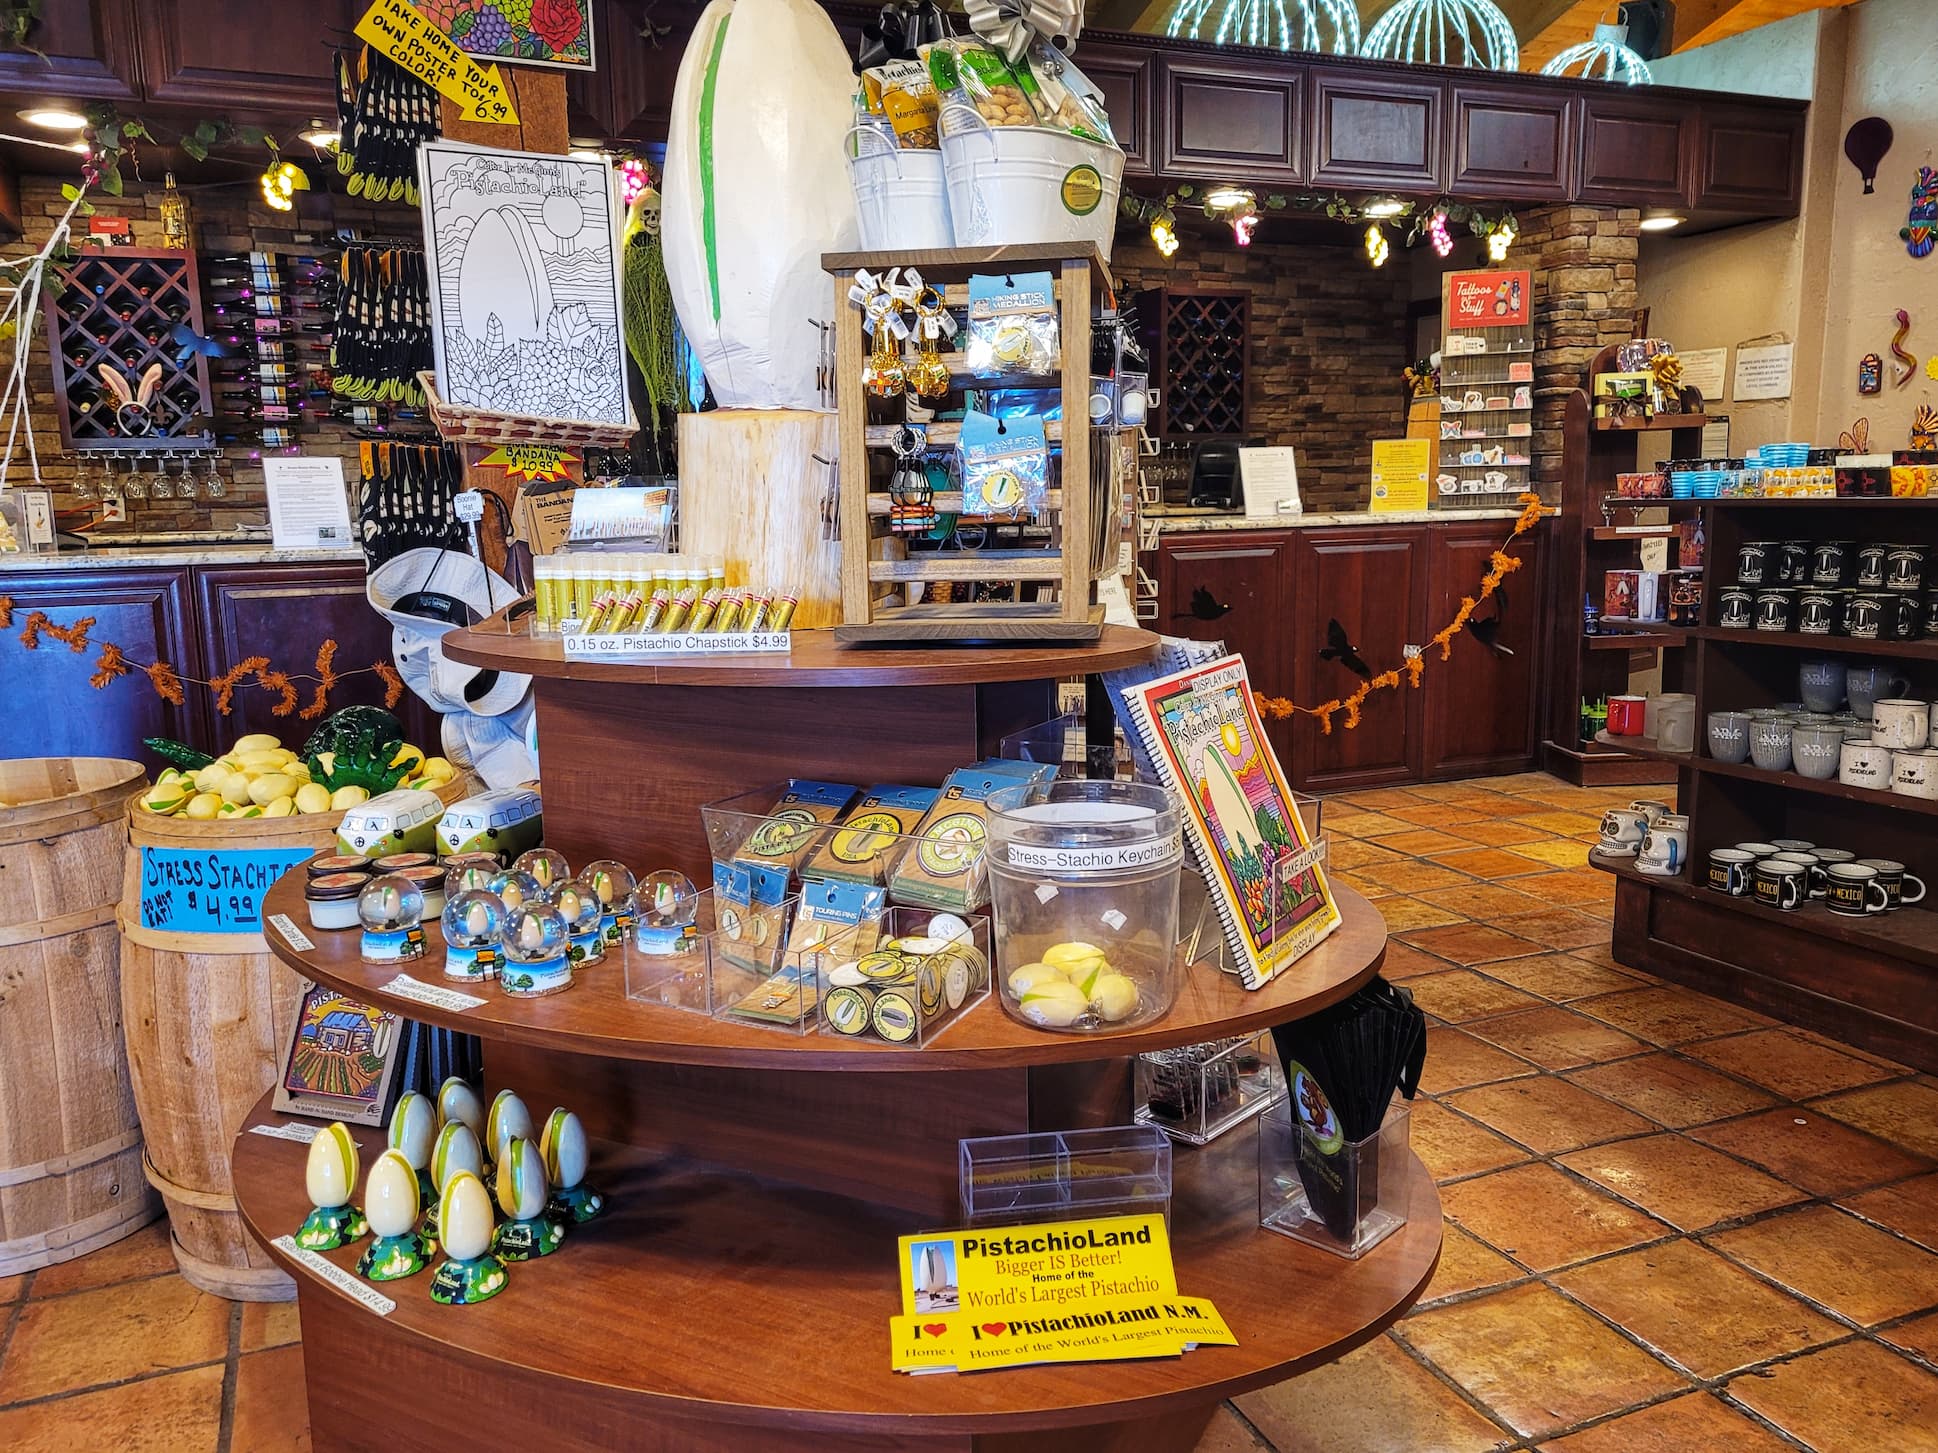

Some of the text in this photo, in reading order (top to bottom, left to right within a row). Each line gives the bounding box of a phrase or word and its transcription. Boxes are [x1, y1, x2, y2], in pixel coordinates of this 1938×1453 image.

[372, 15, 406, 42] OWN
[407, 38, 457, 81] POSTER
[384, 0, 499, 98] TAKE HOME YOUR
[389, 44, 441, 88] COLOR!
[991, 291, 1046, 302] HIKING STICK
[1457, 281, 1493, 297] Tattoos
[993, 298, 1046, 309] MEDALLION
[1459, 299, 1485, 317] Stuff
[505, 446, 561, 464] BANDANA
[462, 503, 473, 511] Hat
[537, 499, 574, 509] BANDAN
[460, 510, 481, 521] $29.99
[567, 634, 789, 651] 0.15 oz. Pistachio Chapstick $4.99
[1193, 665, 1242, 694] DISPLAY ONLY
[1118, 841, 1171, 865] Keychain
[146, 846, 295, 891] STRESS STACHI
[1284, 861, 1299, 880] TAKE
[142, 889, 174, 915] DO NOT
[1836, 884, 1863, 902] MEXICO
[815, 906, 857, 920] TOURING PINS
[963, 1225, 1152, 1259] PistachioLand
[995, 1250, 1123, 1278] Bigger IS Better!
[1032, 1269, 1094, 1283] Home of the
[344, 1280, 368, 1298] Head
[967, 1275, 1160, 1310] World's Largest Pistachio
[971, 1303, 1210, 1341] I PistachioLand N.M.
[913, 1325, 921, 1340] I
[969, 1325, 1225, 1360] Home of the World's Largest Pistachio
[905, 1346, 948, 1359] Home
